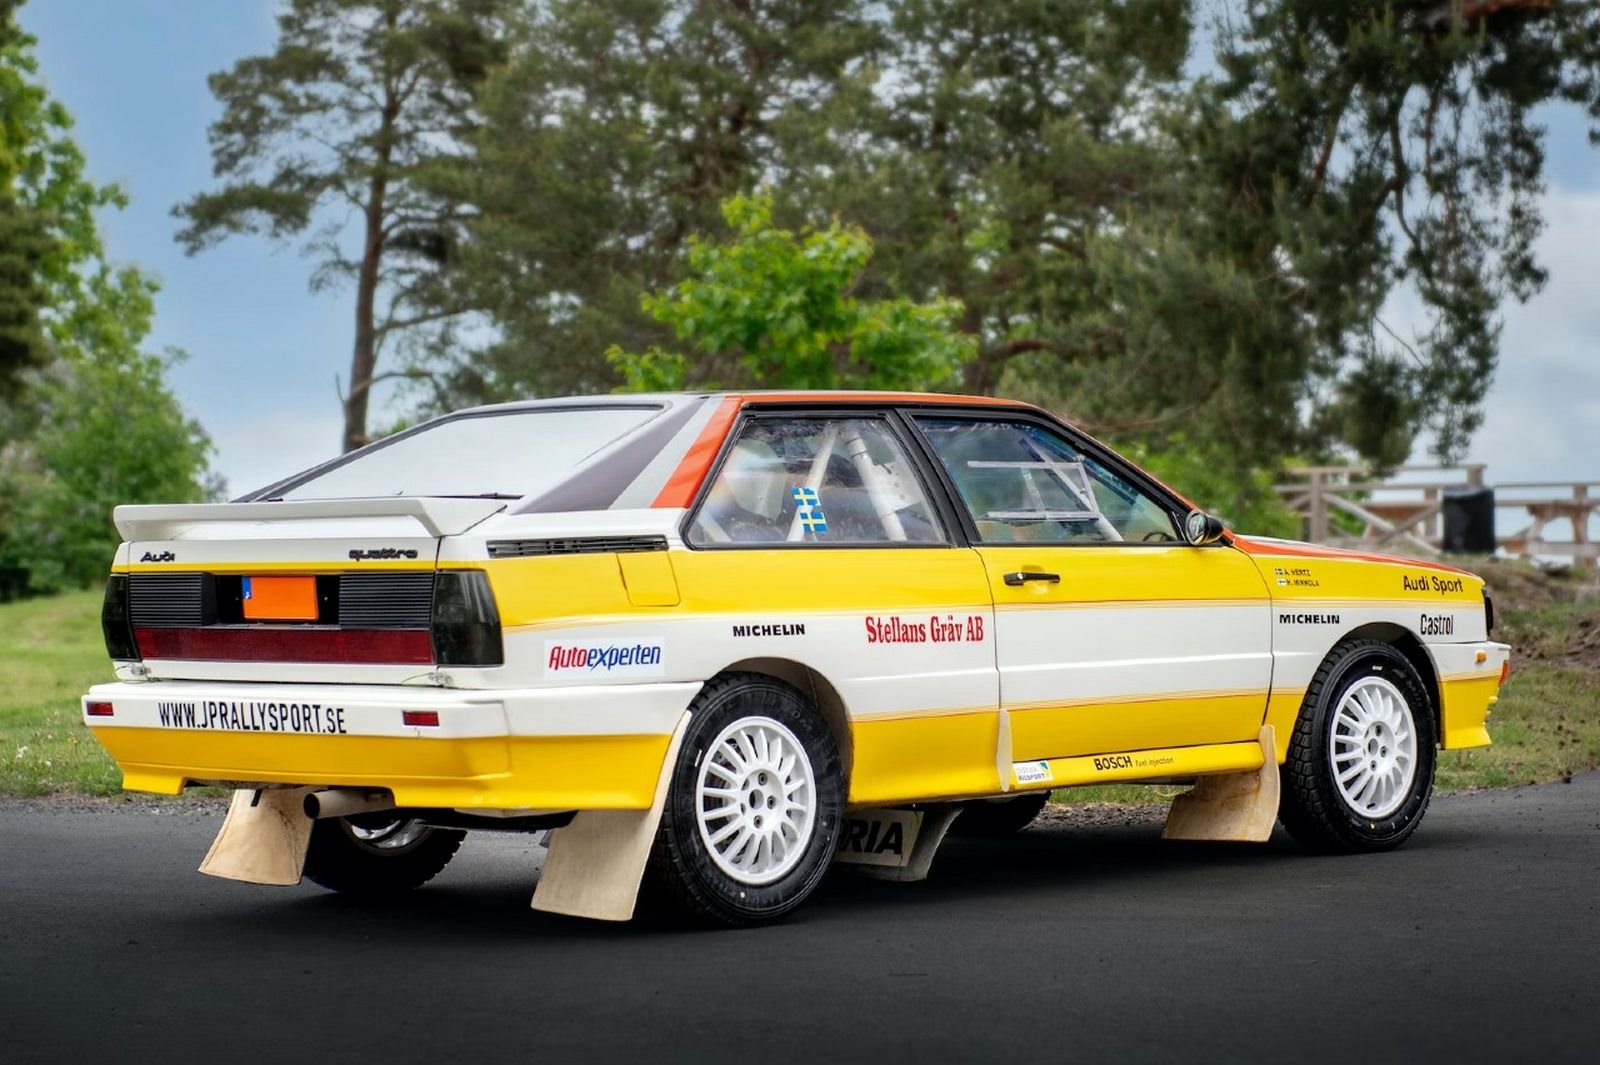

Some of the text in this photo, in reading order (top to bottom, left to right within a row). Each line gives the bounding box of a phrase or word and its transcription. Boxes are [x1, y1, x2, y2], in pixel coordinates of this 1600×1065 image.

[140, 551, 175, 562] Audi
[349, 548, 418, 562] quattro
[1403, 575, 1463, 595] Audi Sport
[1279, 614, 1340, 624] MICHELIN
[1420, 613, 1454, 635] Castrol
[733, 624, 806, 637] MICHELIN
[865, 615, 984, 643] Stellans Gräv AB
[548, 644, 661, 671] Autoexperten
[158, 701, 347, 734] WWW.JPRALLYSPORT.SE
[1093, 756, 1133, 771] BOSCH
[1149, 757, 1174, 767] injection
